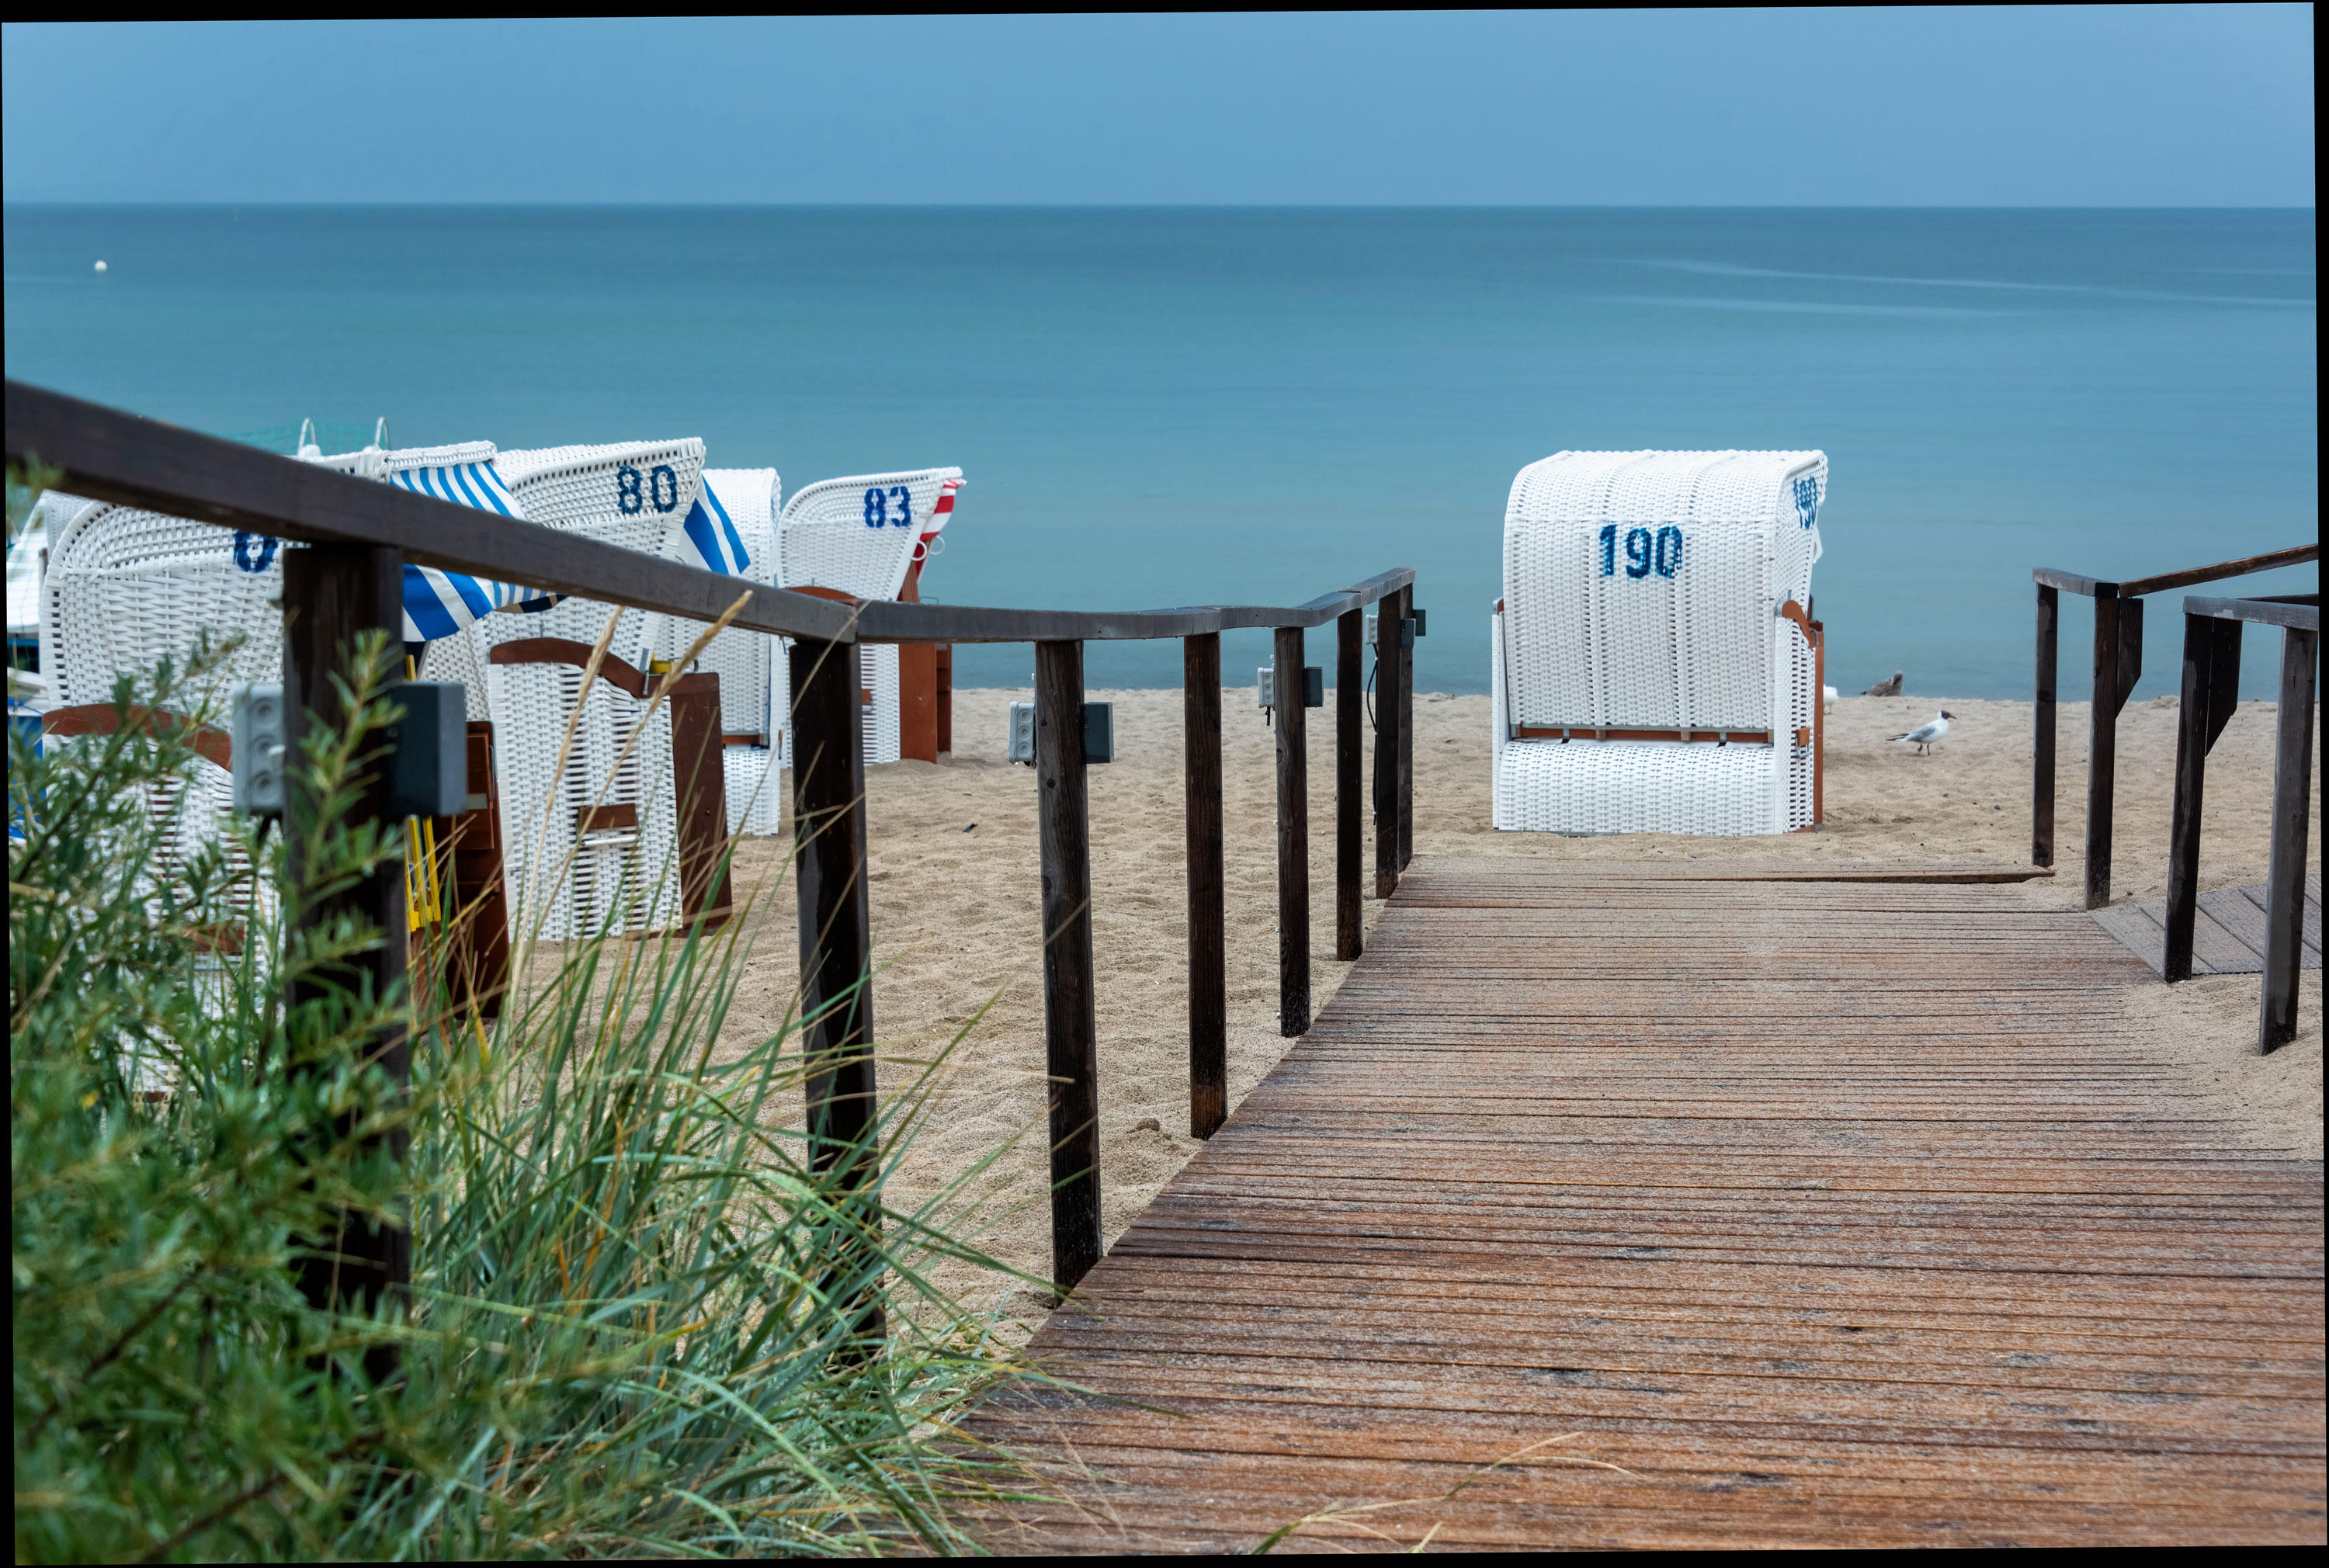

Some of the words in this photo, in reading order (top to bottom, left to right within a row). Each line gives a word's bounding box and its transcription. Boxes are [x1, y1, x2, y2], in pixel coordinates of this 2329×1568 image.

[617, 464, 677, 515] 80
[864, 486, 911, 529] 83
[1599, 524, 1682, 579] 190
